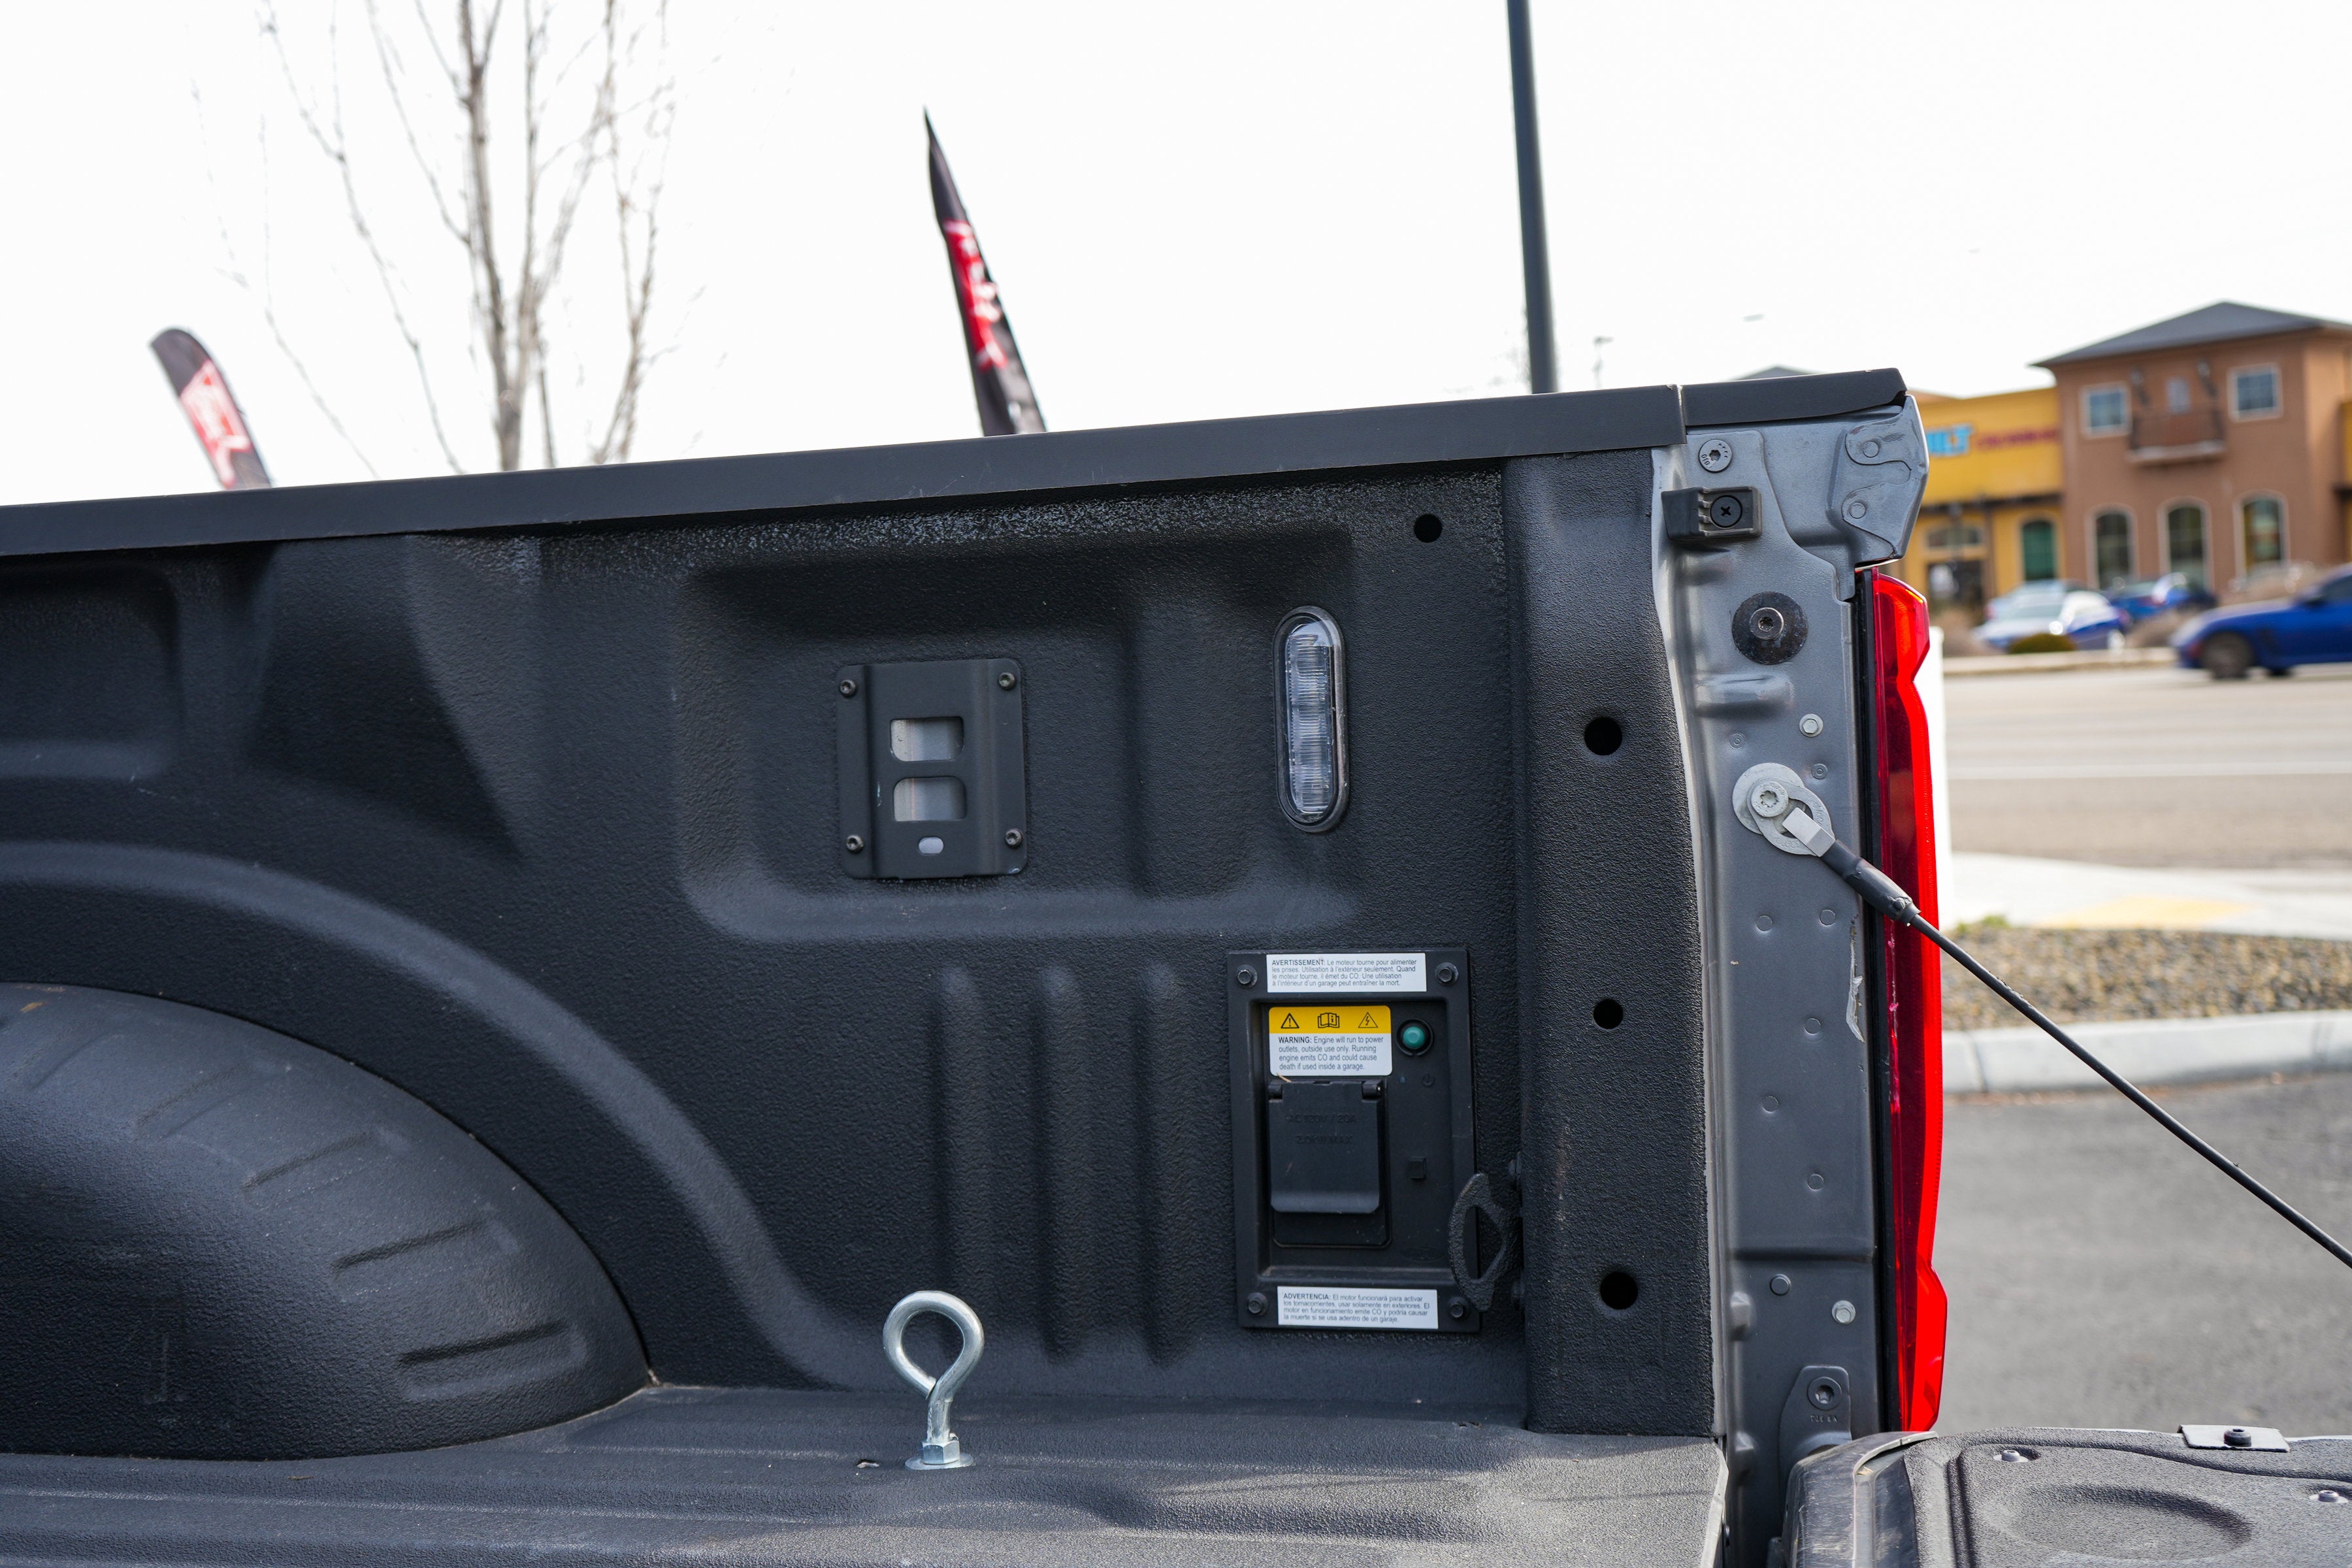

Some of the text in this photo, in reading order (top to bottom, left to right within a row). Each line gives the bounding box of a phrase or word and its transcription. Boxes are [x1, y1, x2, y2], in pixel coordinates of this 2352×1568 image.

[1314, 1036, 1334, 1045] Engine
[1336, 1045, 1350, 1054] only.
[1352, 1045, 1377, 1053] Running
[1279, 1054, 1299, 1063] engine
